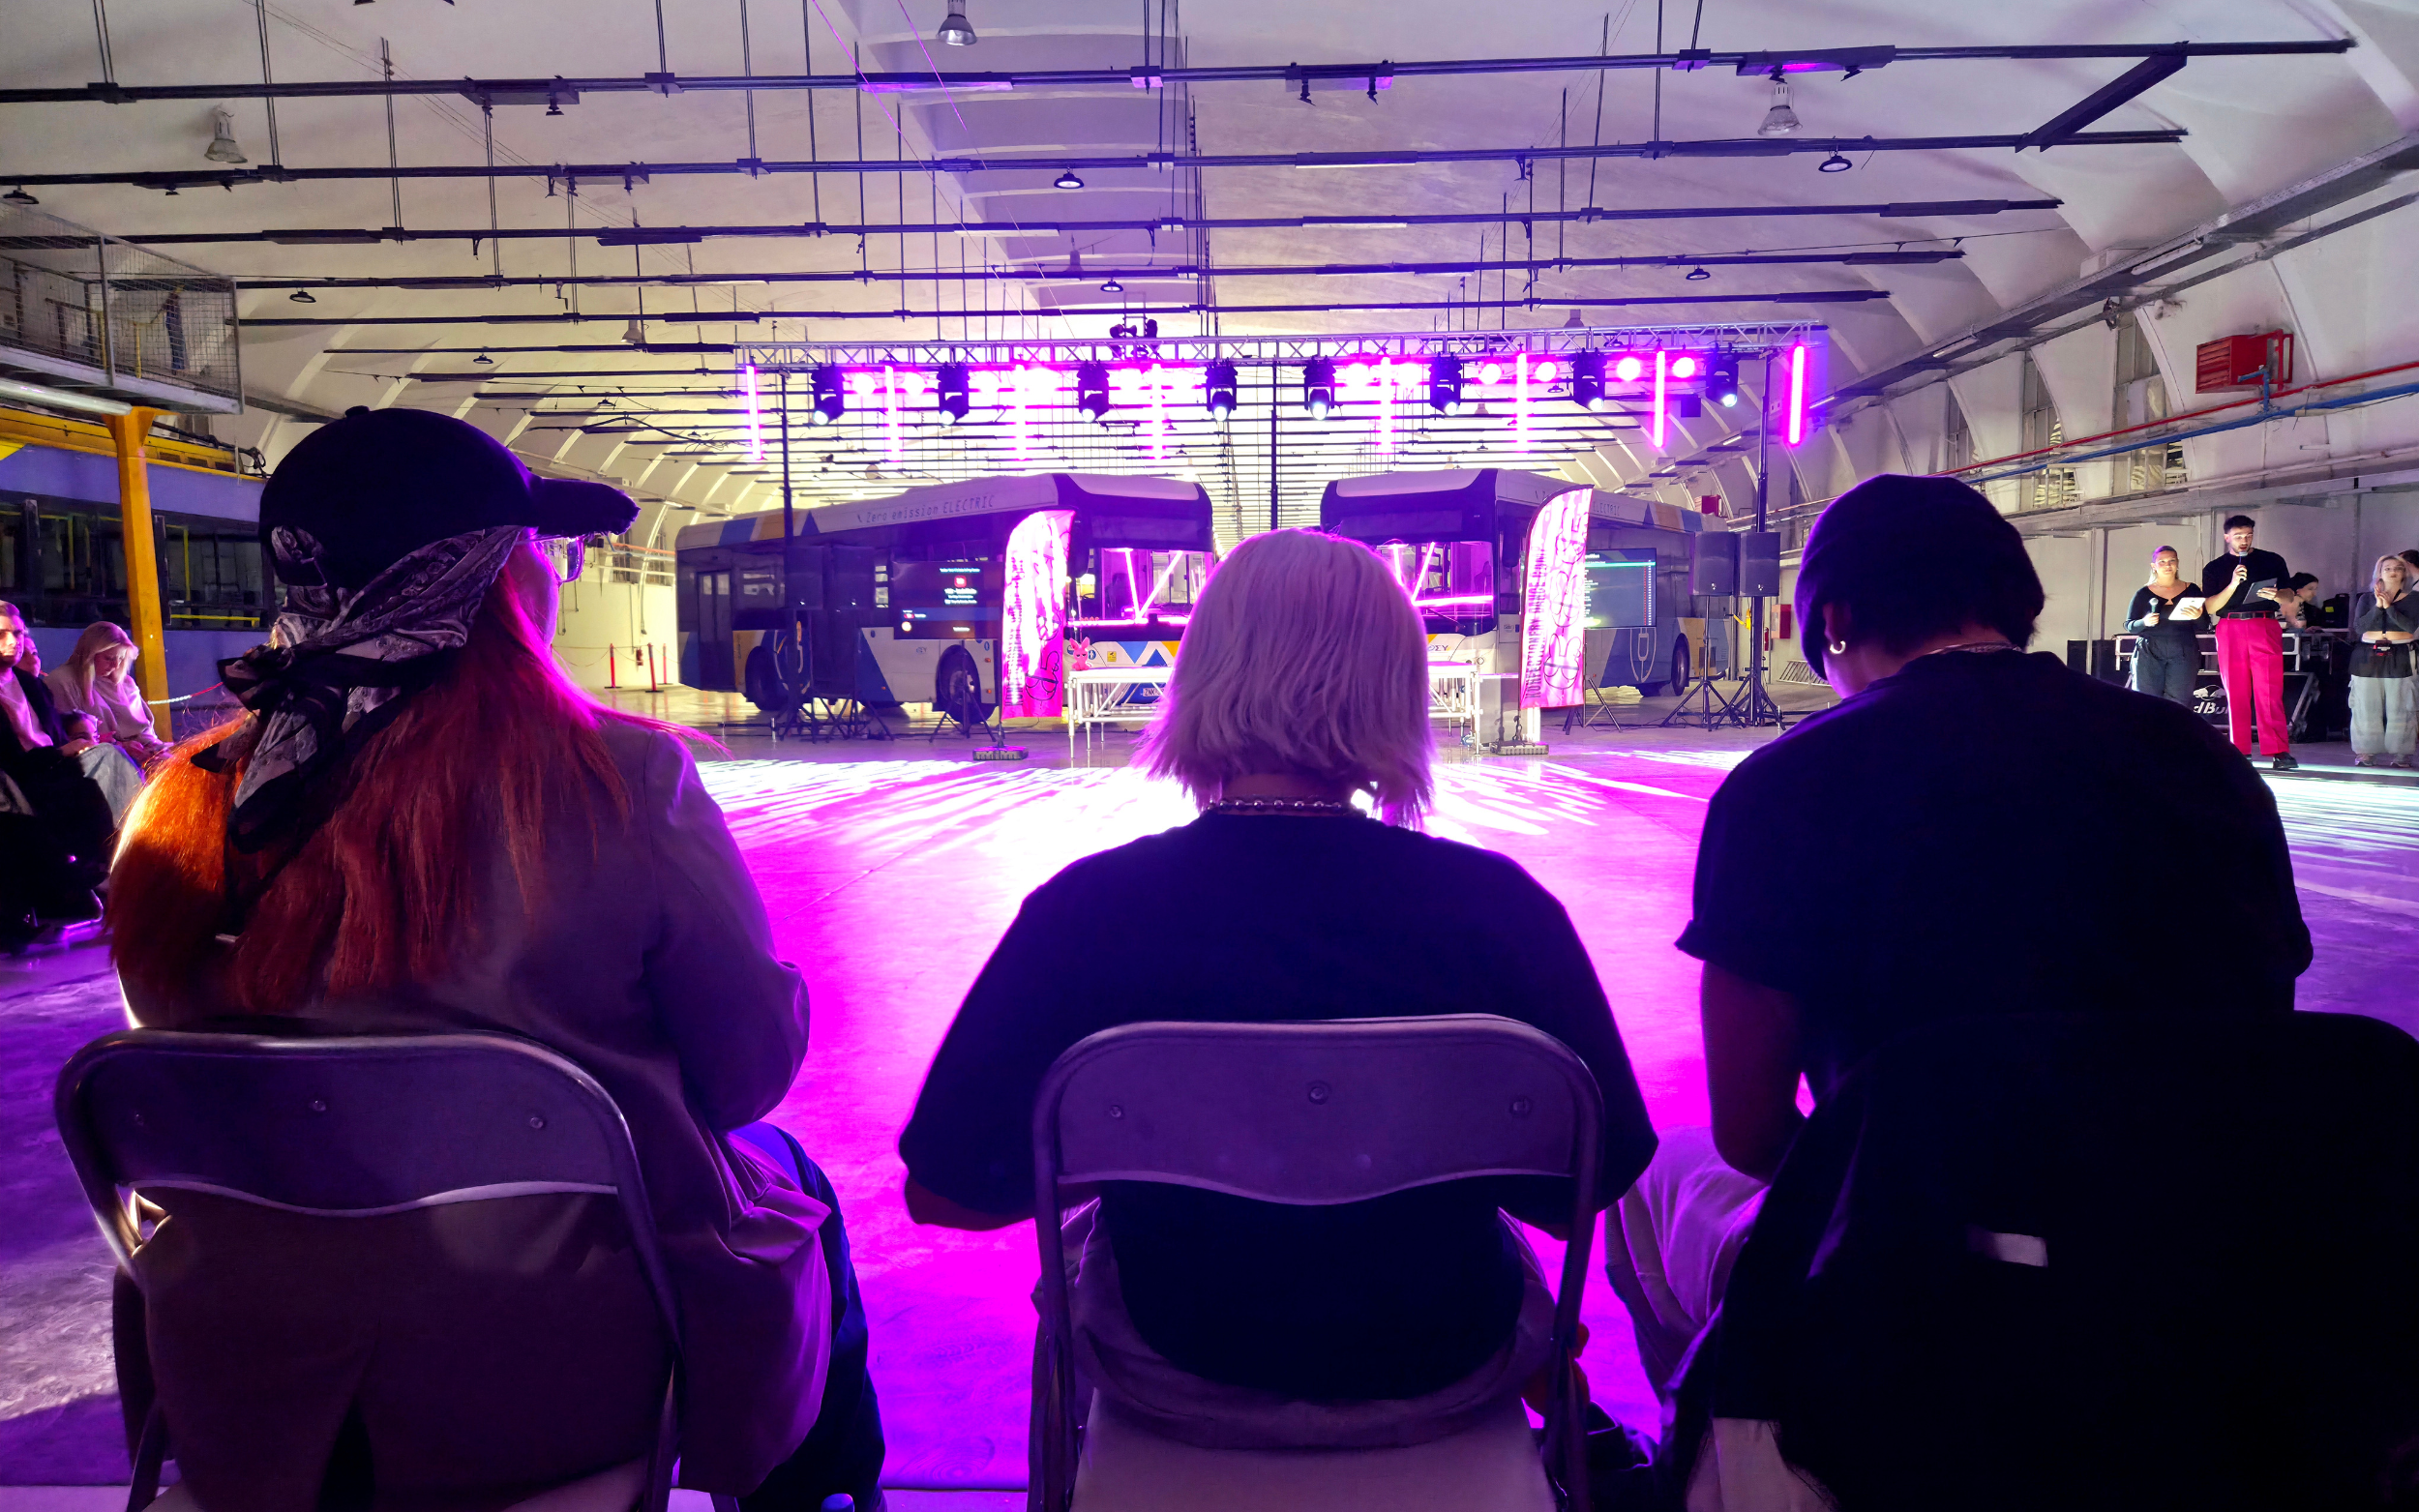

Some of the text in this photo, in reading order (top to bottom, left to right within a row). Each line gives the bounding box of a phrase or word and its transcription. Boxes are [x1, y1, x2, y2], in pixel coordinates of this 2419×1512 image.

[866, 494, 995, 522] Zero emission ELECTRIC
[1528, 581, 1545, 614] DANCE
